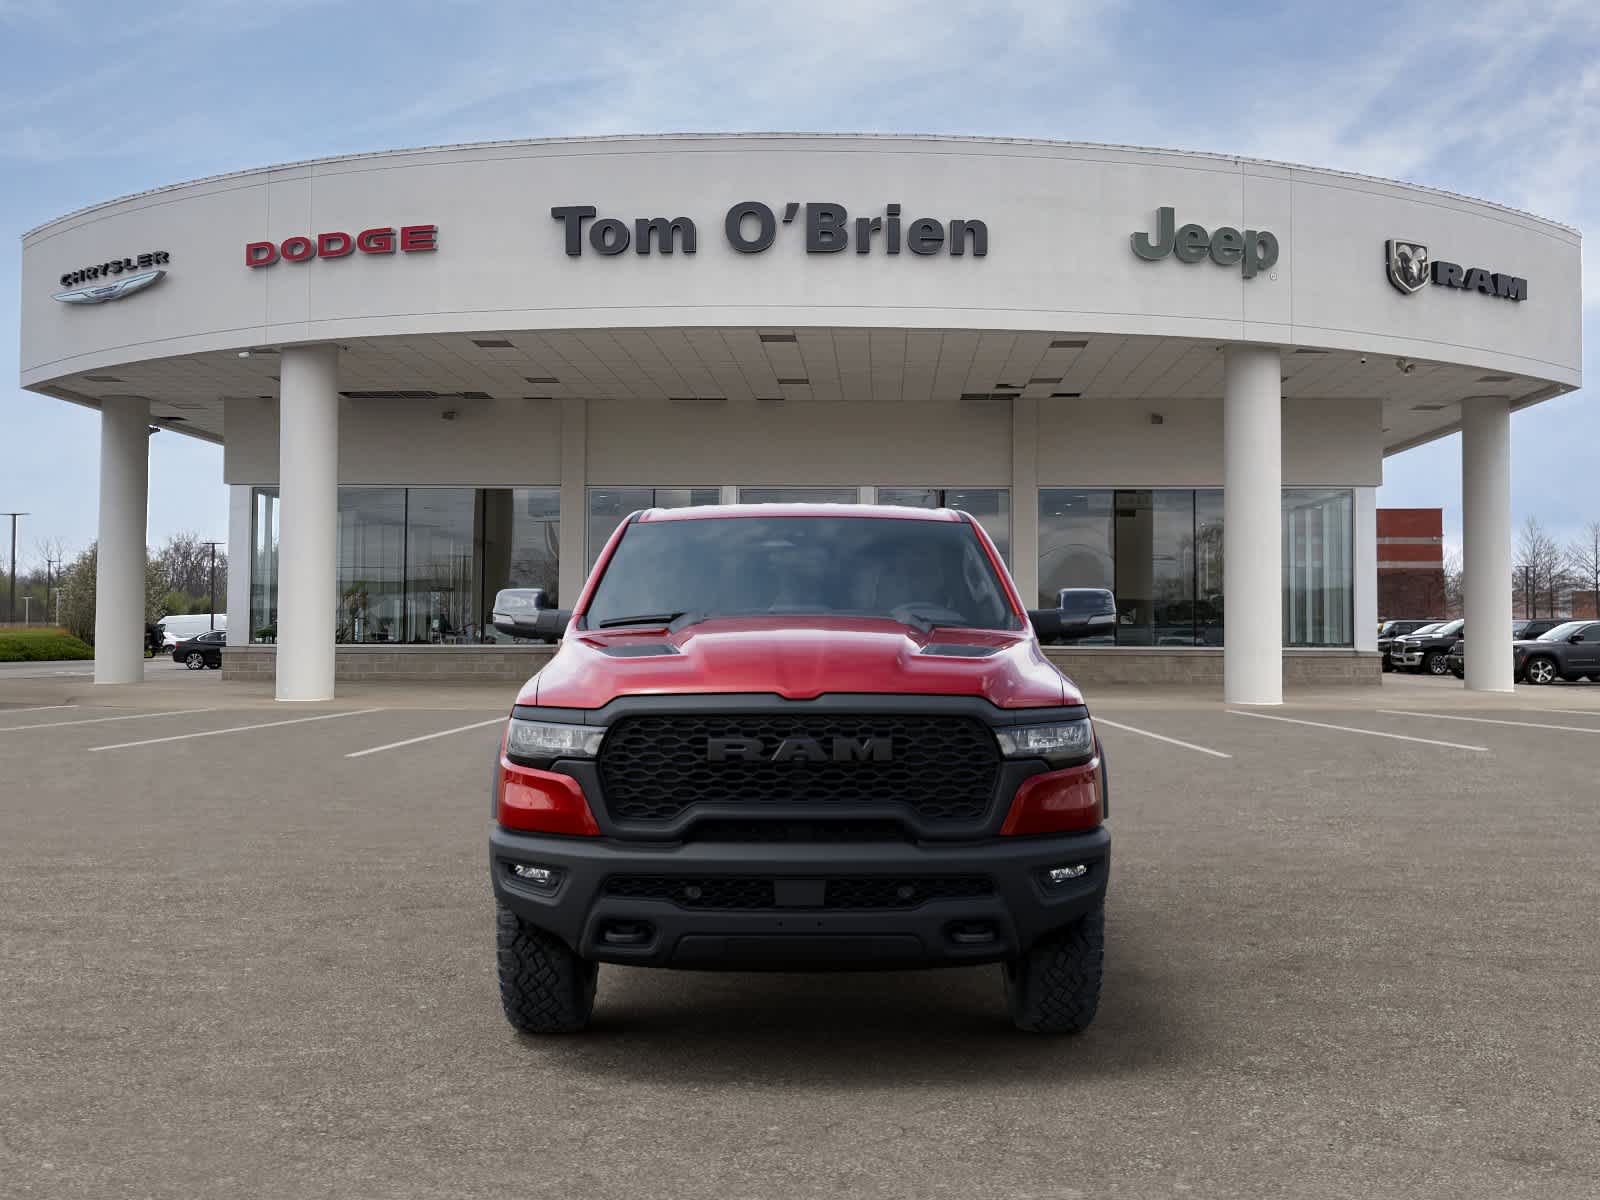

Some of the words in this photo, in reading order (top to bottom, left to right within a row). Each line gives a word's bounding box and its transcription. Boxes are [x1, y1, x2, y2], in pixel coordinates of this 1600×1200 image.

[245, 225, 438, 268] DODGE
[551, 205, 697, 257] Tom
[724, 201, 989, 257] O'Brien
[1130, 207, 1280, 279] Jeep
[60, 251, 169, 287] CHRYSLER
[1431, 261, 1528, 302] RAM
[707, 736, 894, 762] RAM
